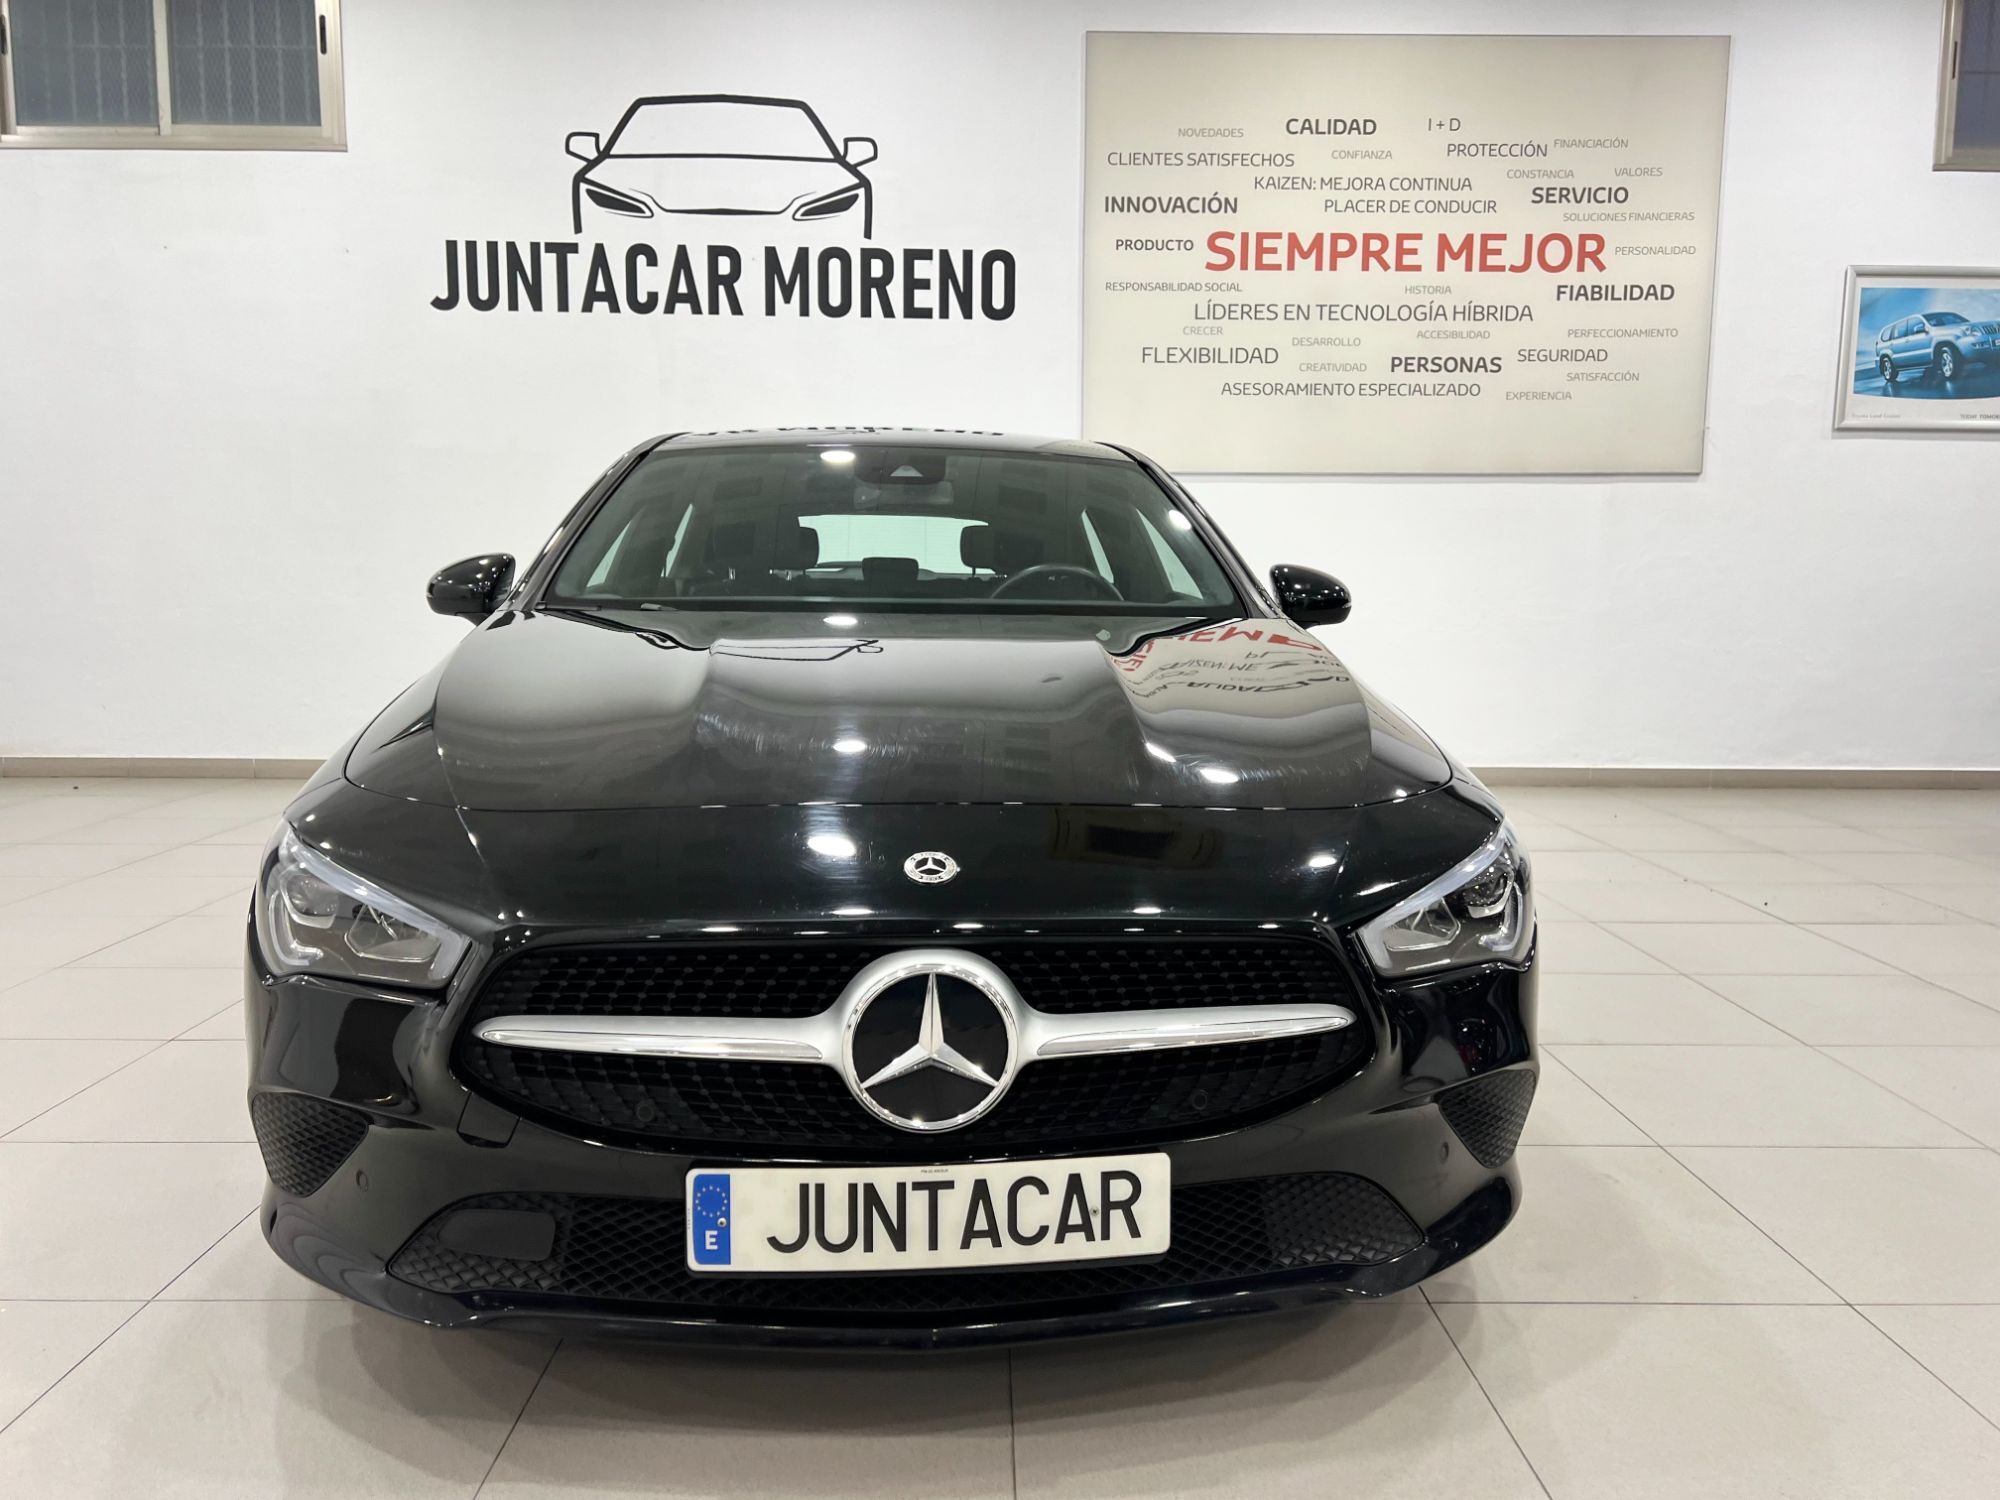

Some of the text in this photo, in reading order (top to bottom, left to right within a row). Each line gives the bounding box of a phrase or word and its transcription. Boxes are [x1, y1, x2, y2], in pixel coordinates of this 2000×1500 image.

[1285, 117, 1377, 136] CALIDAD
[1435, 120, 1446, 130] +
[1449, 117, 1462, 132] D
[1177, 127, 1244, 139] NOVEDADES
[1446, 140, 1548, 158] PROTECCIÓN
[1553, 137, 1629, 149] FINANCIACIÓN
[1107, 151, 1295, 168] CLIENTES SATISFECHOS
[1331, 149, 1393, 161] CONFIANZA
[1506, 168, 1575, 180] CONSTANCIA
[1614, 167, 1664, 177] VALORES
[1253, 176, 1473, 192] KAIZEN: MEJORA CONTINUA
[1104, 191, 1239, 214] INNOVACIÓN
[1530, 186, 1629, 204] SERVICIO
[1324, 199, 1497, 214] PLACER DE CONDUCIR
[1562, 211, 1695, 222] SOLUCIONES FINANCIERAS
[1115, 238, 1194, 251] PRODUCTO
[1204, 230, 1607, 274] SIEMPRE MEJOR
[1614, 245, 1696, 256] PERSONALIDAD
[429, 239, 1017, 321] JUNTACAR MORENO
[1105, 281, 1243, 293] RESPONSABILIDAD SOCIAL
[1404, 284, 1452, 296] HISTORIA
[1555, 283, 1675, 302] FIABILIDAD
[1193, 298, 1534, 322] LÍDERES EN TECNOLOGÍA HÍBRIDA
[1182, 325, 1224, 336] CRECER
[1416, 329, 1491, 340] ACCESIBILIDAD
[1567, 327, 1679, 339] PERFECCIONAMIENTO
[1291, 337, 1361, 348] DESARROLLO
[1141, 346, 1279, 365] FLEXIBILIDAD
[1517, 348, 1609, 363] SEGURIDAD
[1298, 362, 1367, 373] CREATIVIDAD
[1390, 356, 1502, 374] PERSONAS
[1566, 371, 1640, 383] SATISFACCIÓN
[1220, 382, 1481, 397] ASESORAMIENTO ESPECIALIZADO
[1505, 390, 1573, 401] EXPERIENCIA
[766, 1169, 1143, 1254] JUNTACAR
[704, 1230, 718, 1251] E
